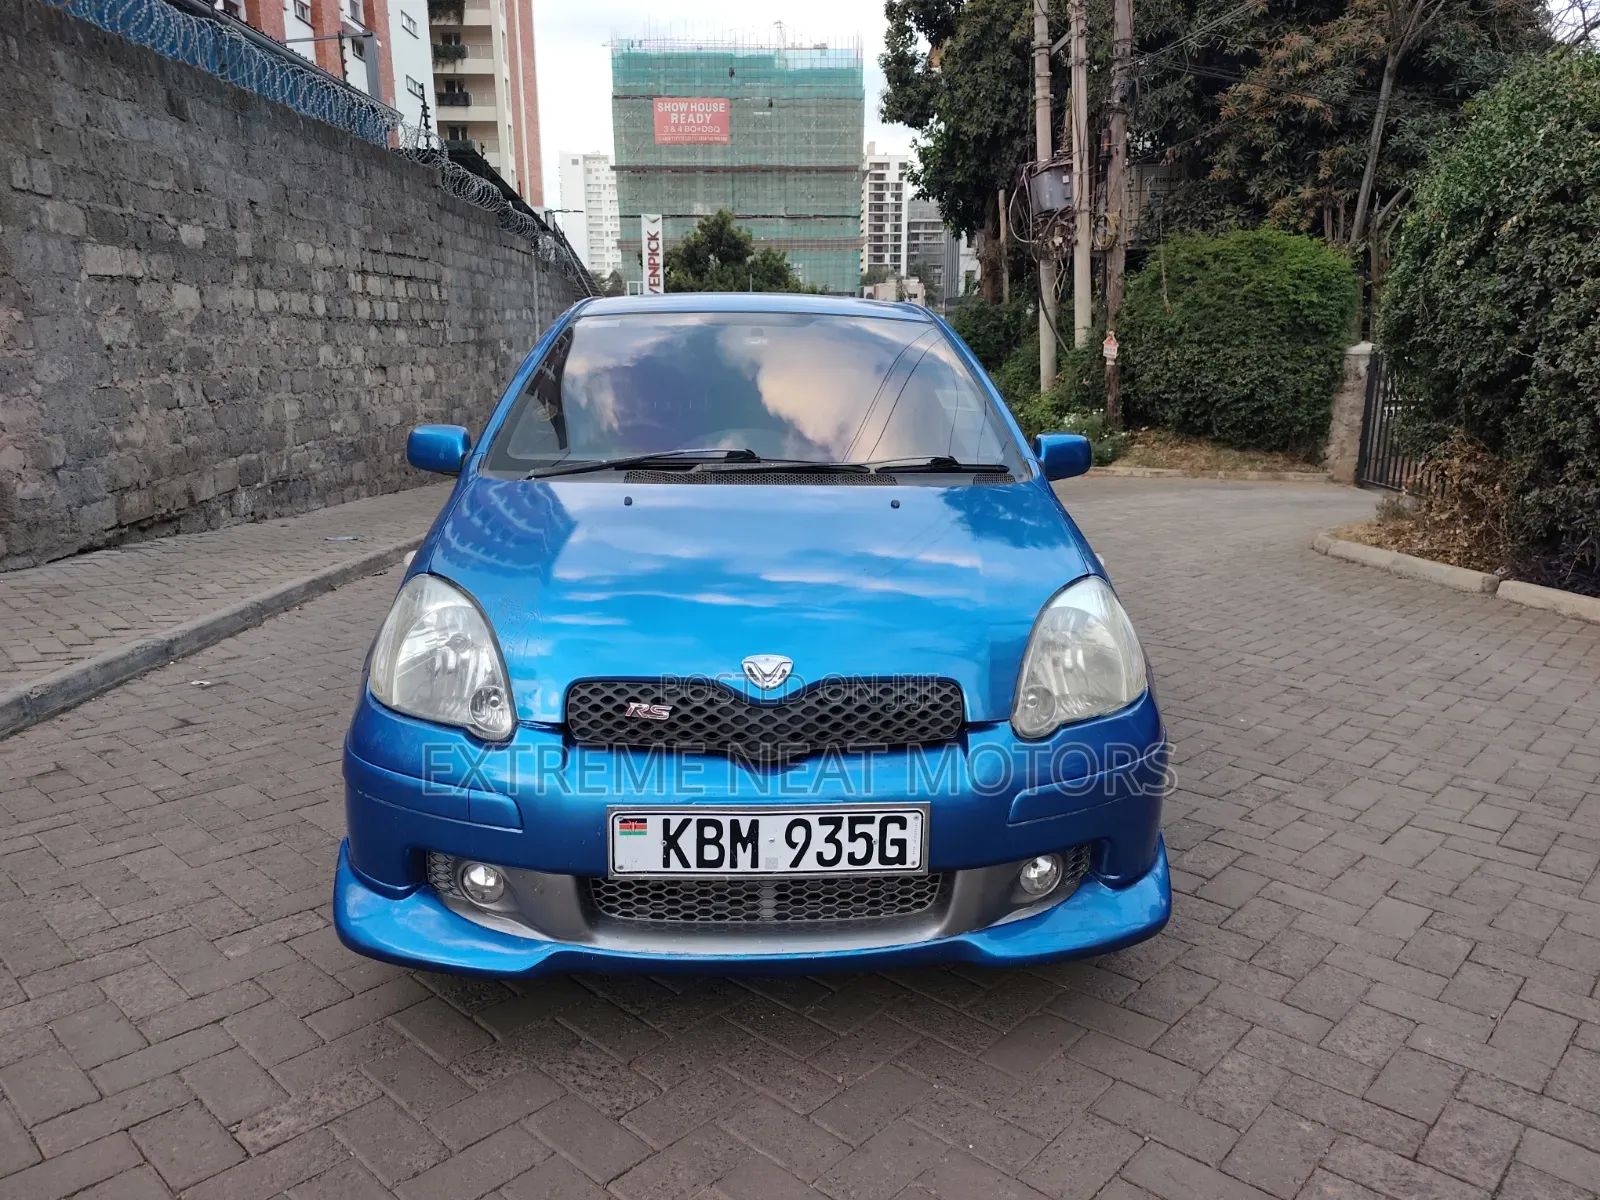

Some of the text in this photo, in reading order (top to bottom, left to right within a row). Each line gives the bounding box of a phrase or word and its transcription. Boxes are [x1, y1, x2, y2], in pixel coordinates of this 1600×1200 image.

[657, 102, 726, 113] SHOW HOUSE
[670, 113, 712, 124] READY
[663, 125, 669, 133] 3
[670, 125, 677, 133] &
[677, 125, 683, 133] 4
[625, 701, 673, 720] RS
[662, 818, 760, 869] KBM
[784, 815, 907, 868] 935G
